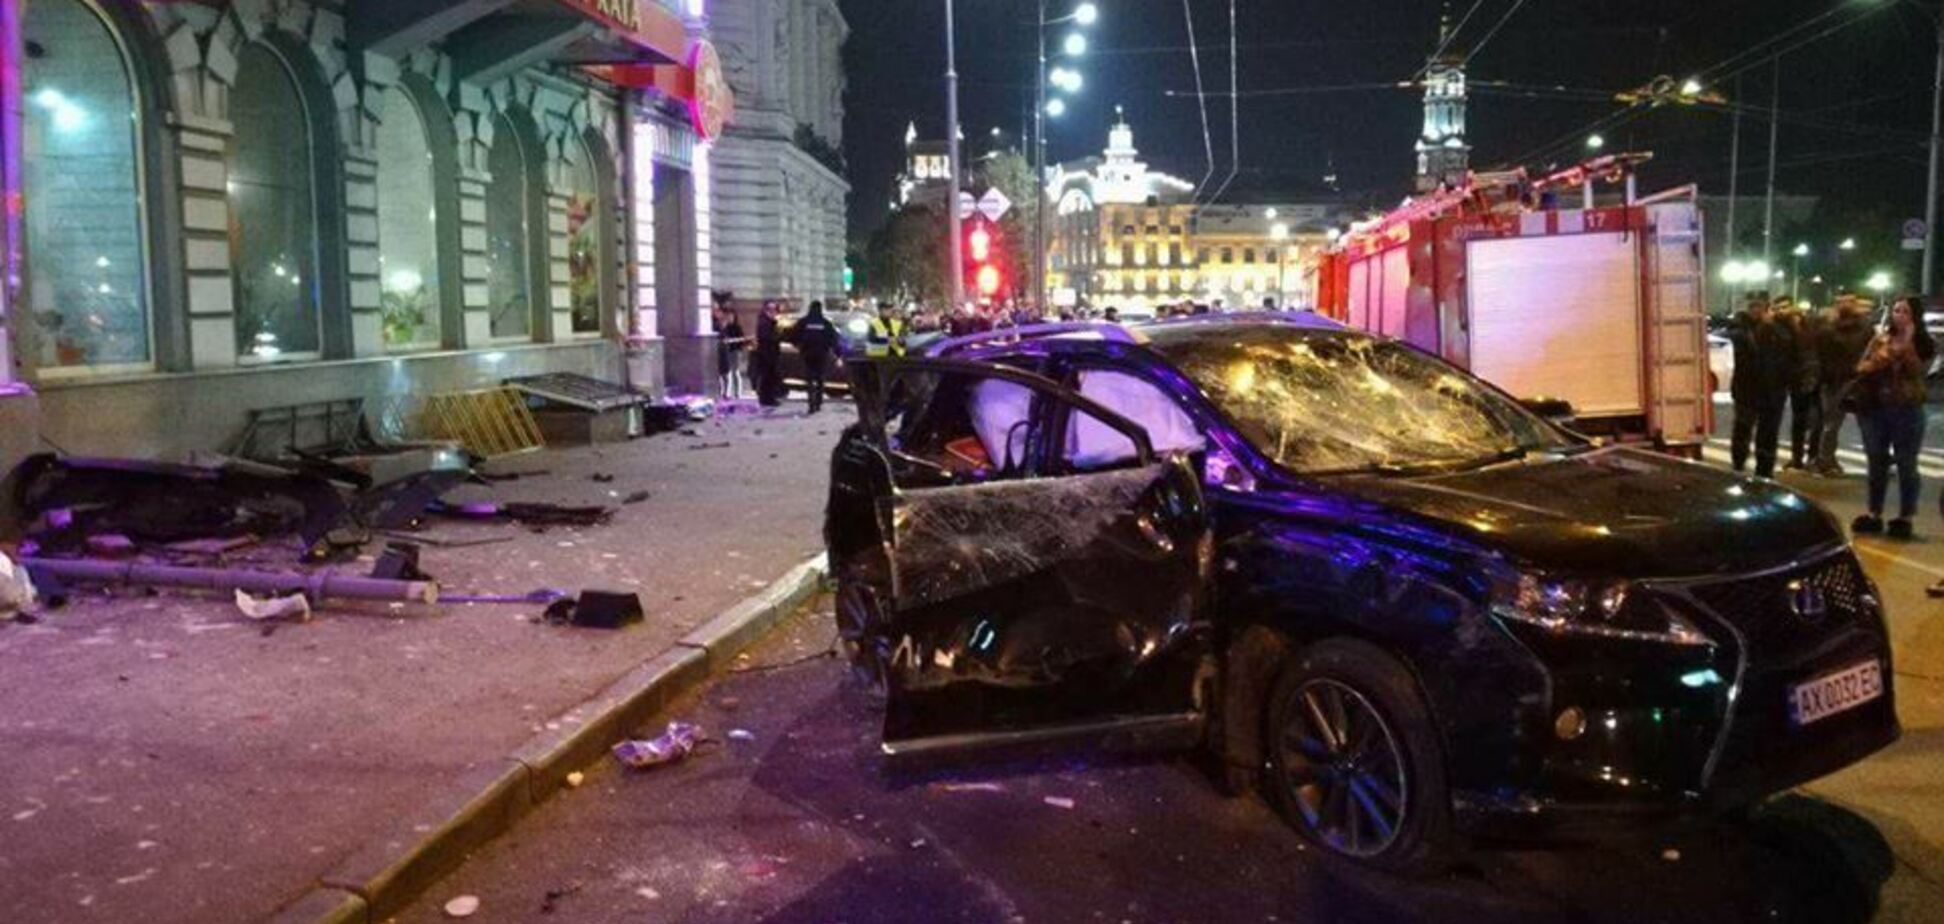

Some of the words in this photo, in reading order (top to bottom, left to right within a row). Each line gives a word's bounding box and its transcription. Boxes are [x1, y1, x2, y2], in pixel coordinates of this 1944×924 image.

[1587, 211, 1606, 228] 17
[1801, 684, 1826, 718] AX
[1825, 673, 1859, 709] 0032
